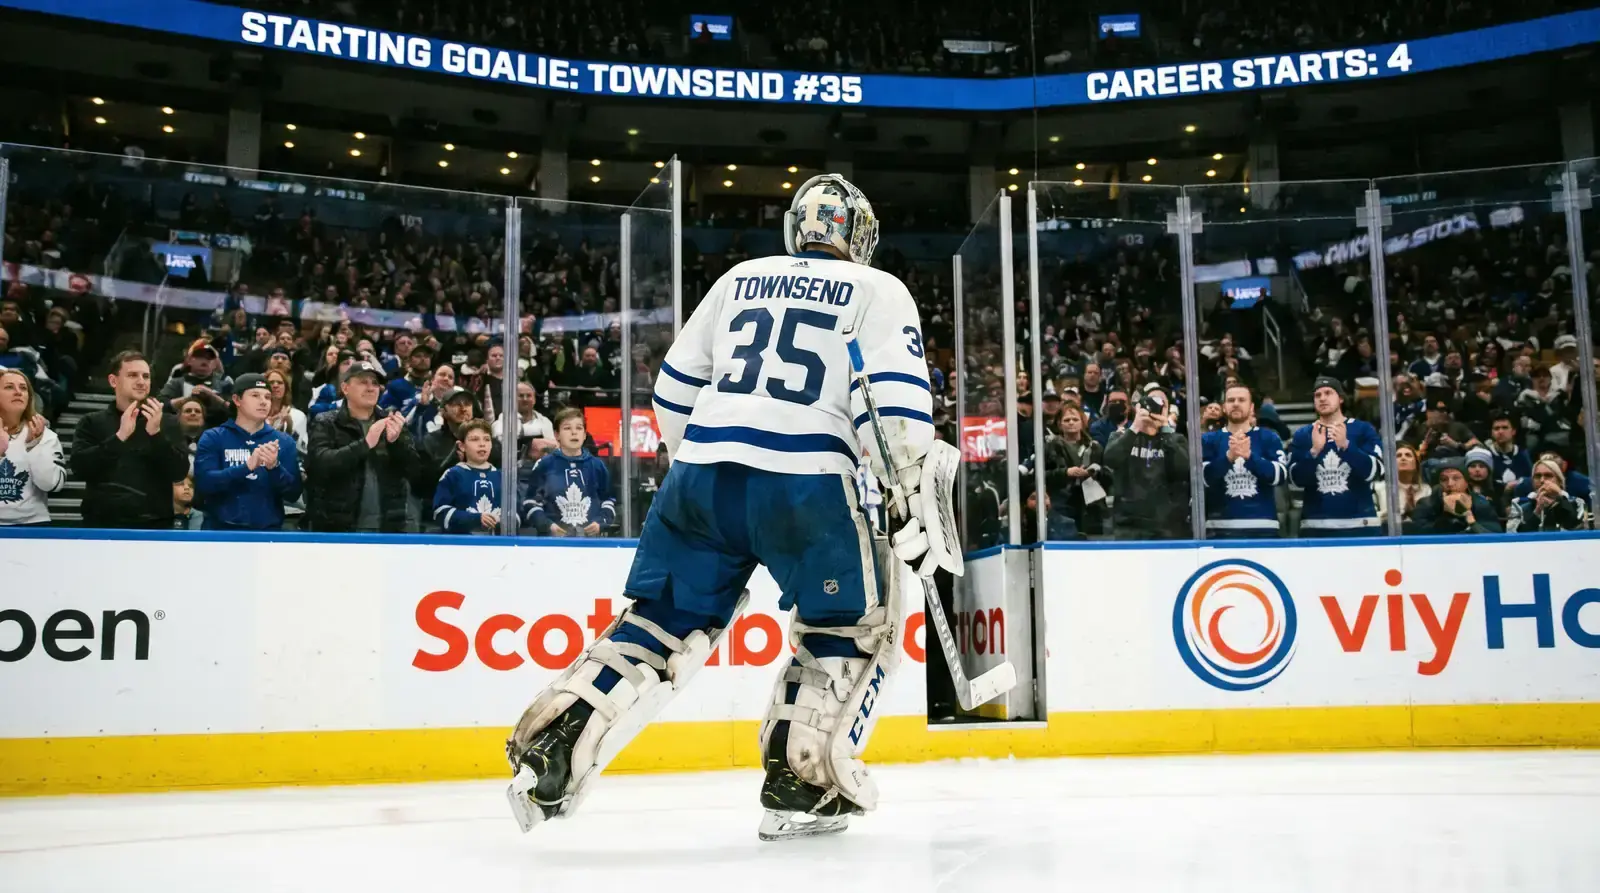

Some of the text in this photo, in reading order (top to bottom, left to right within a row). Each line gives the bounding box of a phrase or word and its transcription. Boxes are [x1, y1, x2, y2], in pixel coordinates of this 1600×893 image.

[241, 11, 863, 103] STARTING GOALIE: TOWNSEND #35
[1086, 43, 1413, 101] CAREER STARTS: 4
[734, 275, 854, 307] TOWNSEND
[717, 307, 838, 406] 35
[848, 663, 885, 746] CCM
